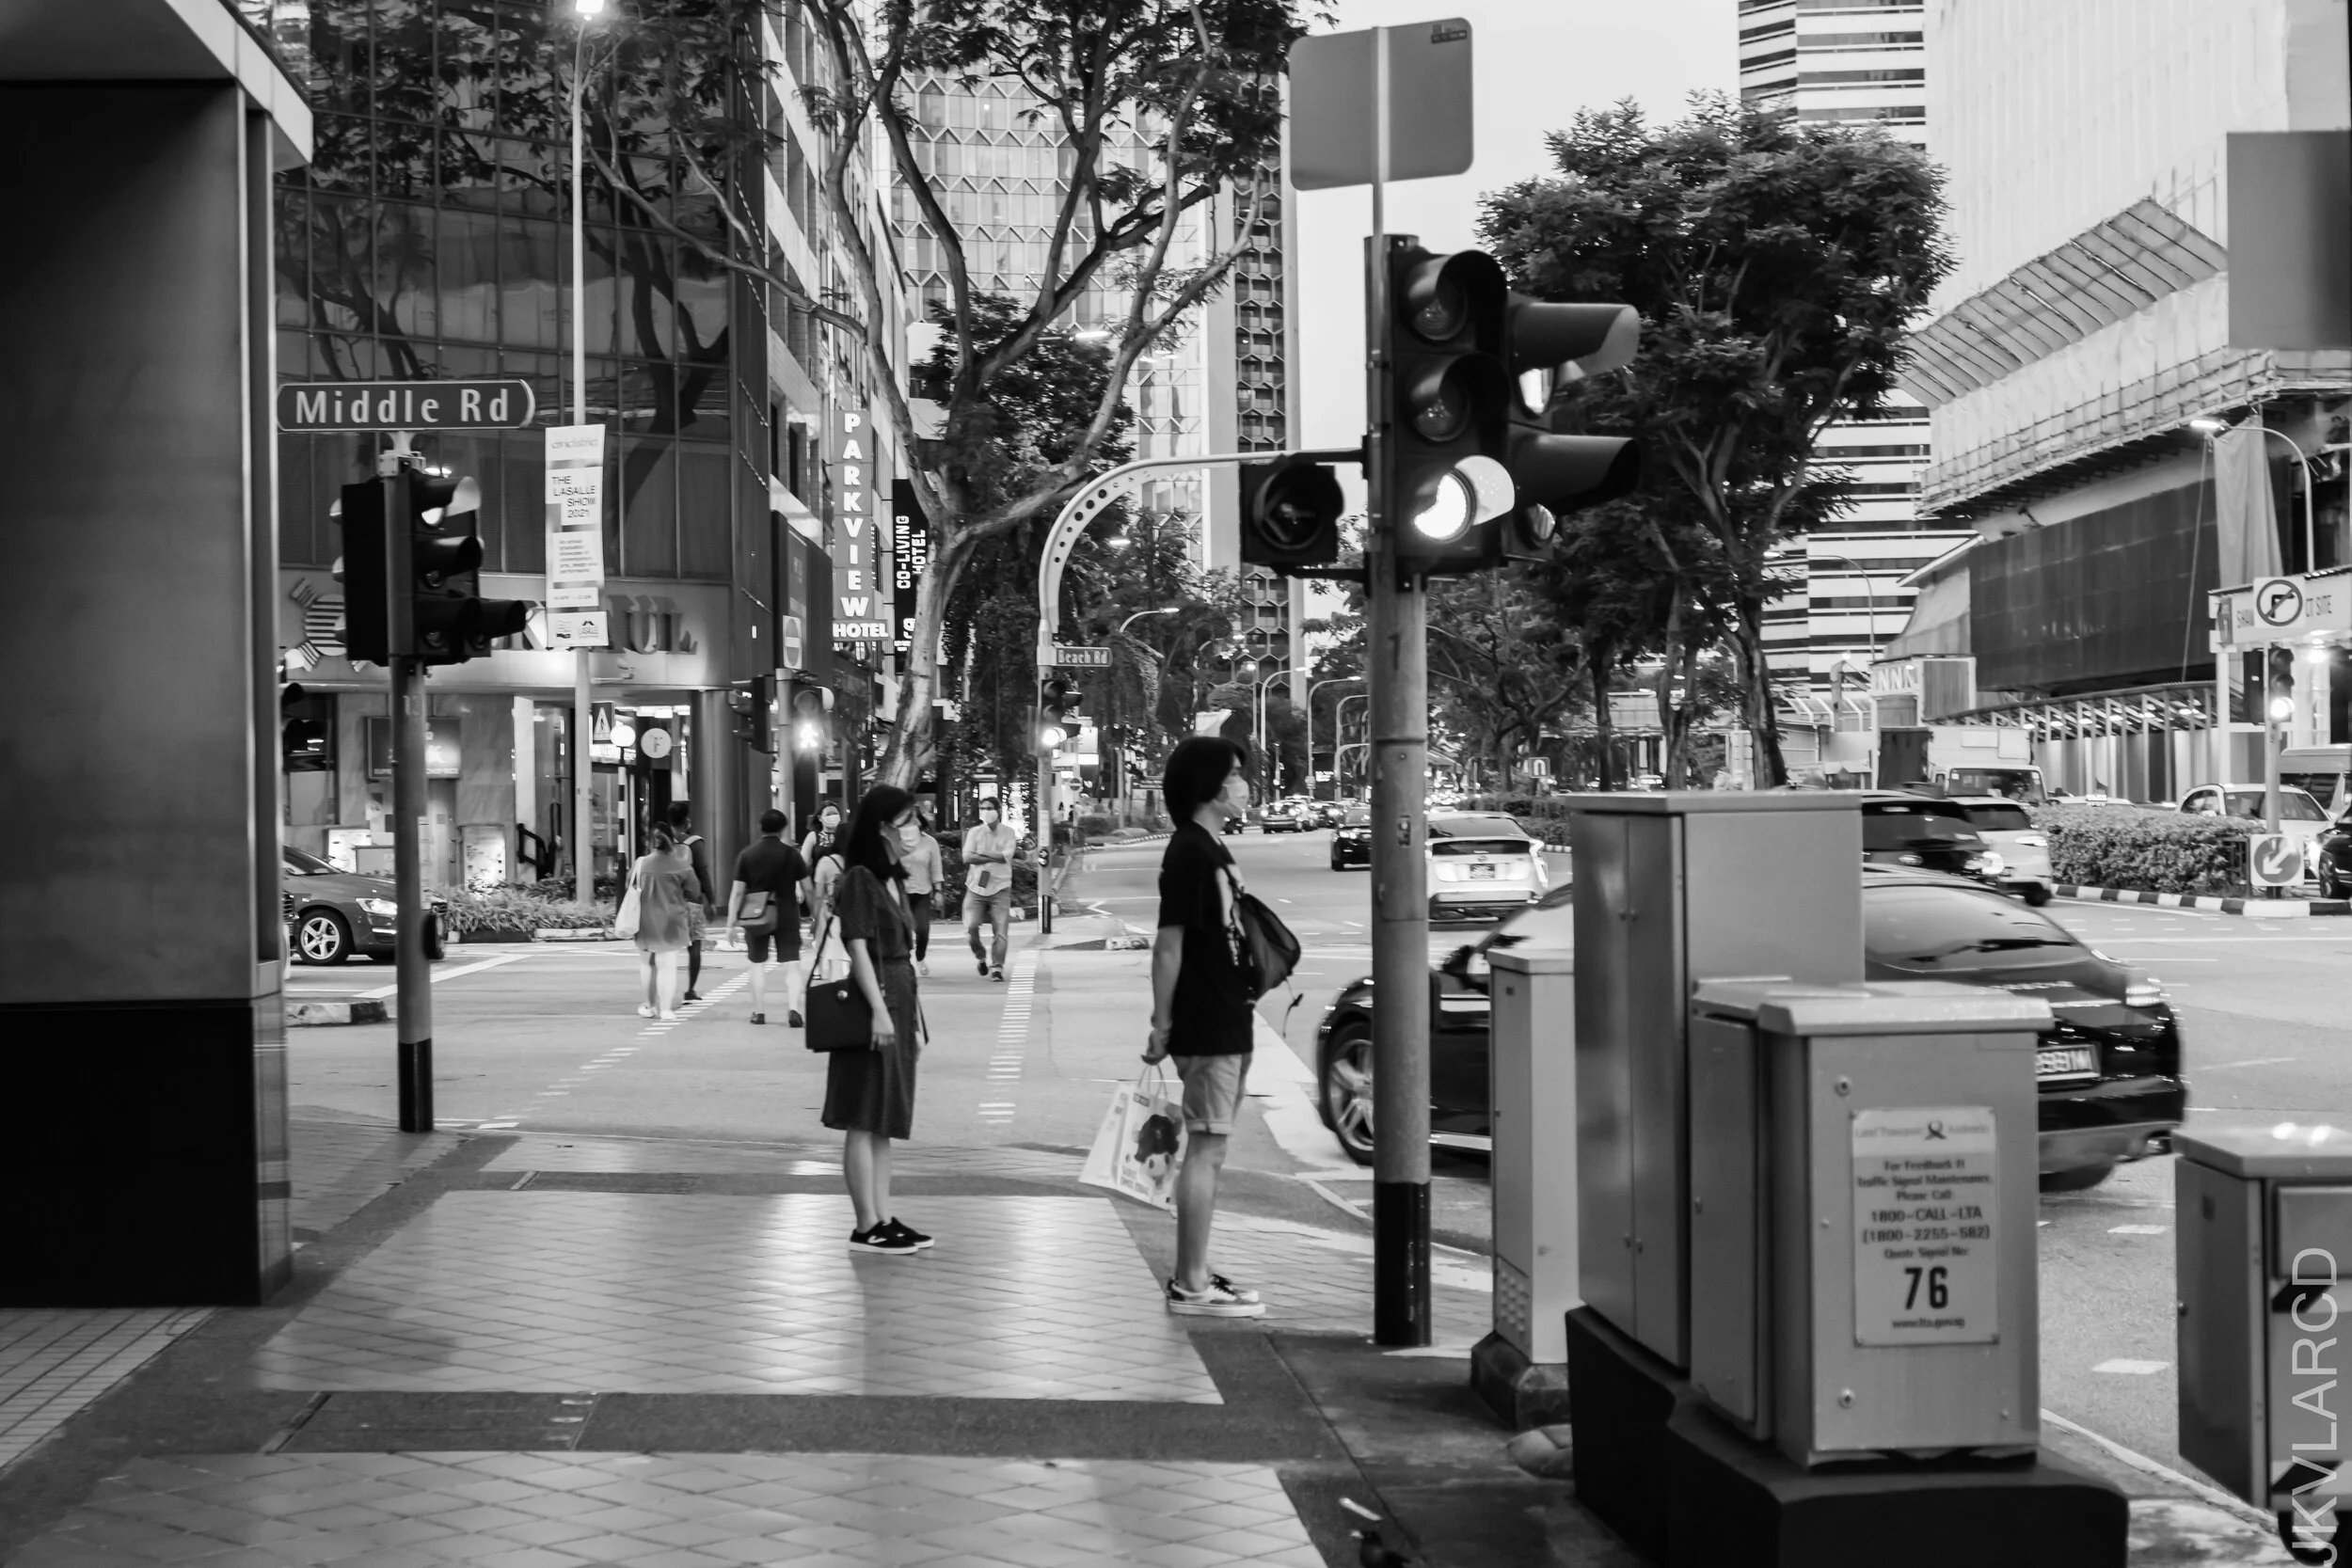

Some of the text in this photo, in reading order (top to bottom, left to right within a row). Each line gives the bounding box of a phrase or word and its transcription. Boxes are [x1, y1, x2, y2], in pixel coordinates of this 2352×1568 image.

[296, 388, 508, 423] Middle Rd
[551, 476, 571, 485] THE
[567, 498, 596, 507] SHOW
[840, 413, 869, 617] PARKVIEW
[896, 515, 911, 589] CO-LIVING
[912, 530, 926, 575] HOTEL
[833, 623, 888, 638] HOTEL
[1058, 650, 1107, 664] Beach Rd
[1904, 1159, 1952, 1170] Feedback
[1892, 1176, 1922, 1189] Signal
[1917, 1246, 1948, 1259] Signal
[1904, 1266, 1948, 1310] 76
